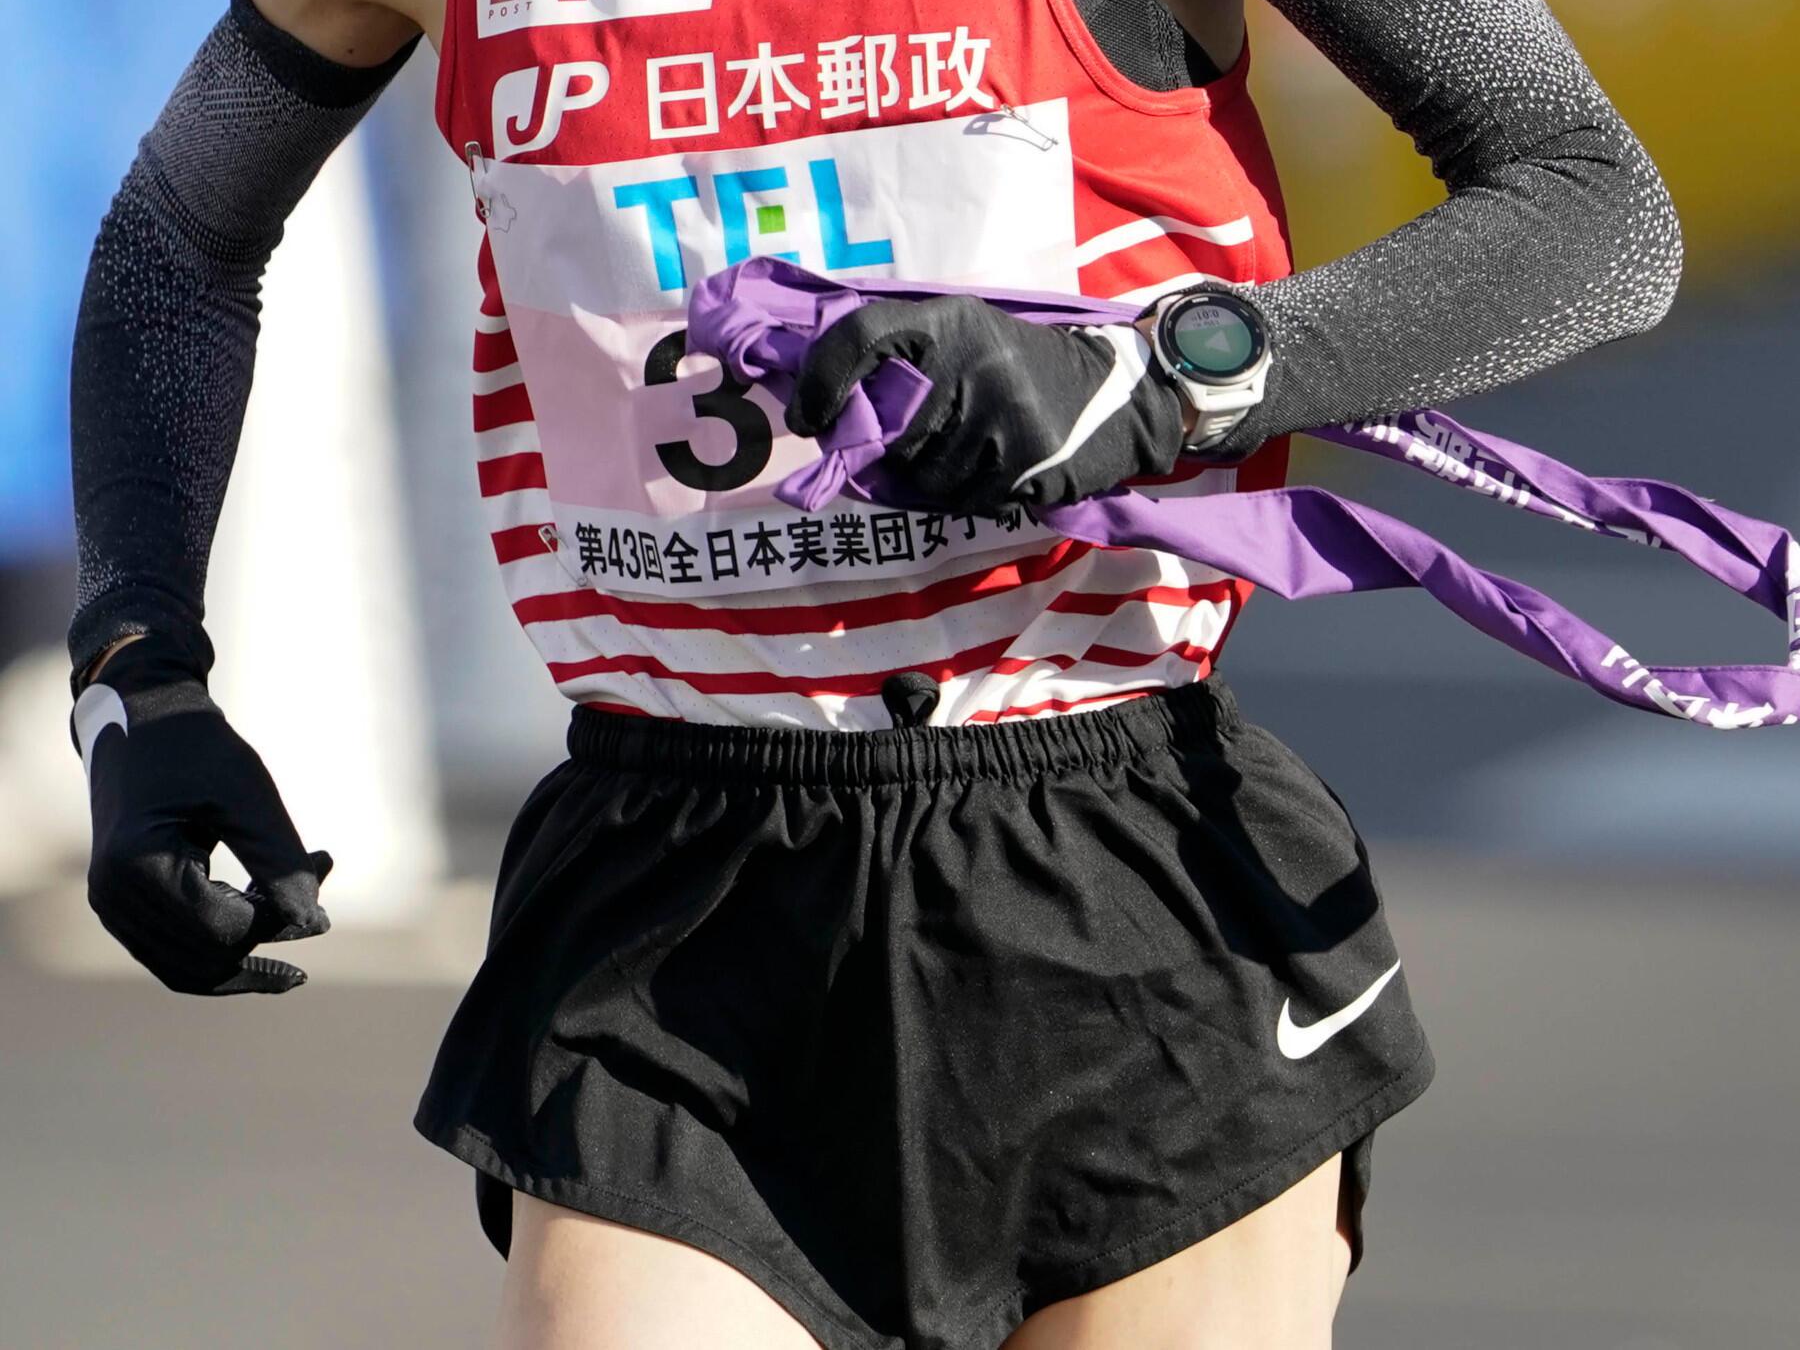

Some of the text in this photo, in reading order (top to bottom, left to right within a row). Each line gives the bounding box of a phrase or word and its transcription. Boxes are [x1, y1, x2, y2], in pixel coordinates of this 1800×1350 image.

[488, 1, 533, 20] POST
[646, 25, 997, 140] 日本郵政
[613, 158, 894, 292] TEL
